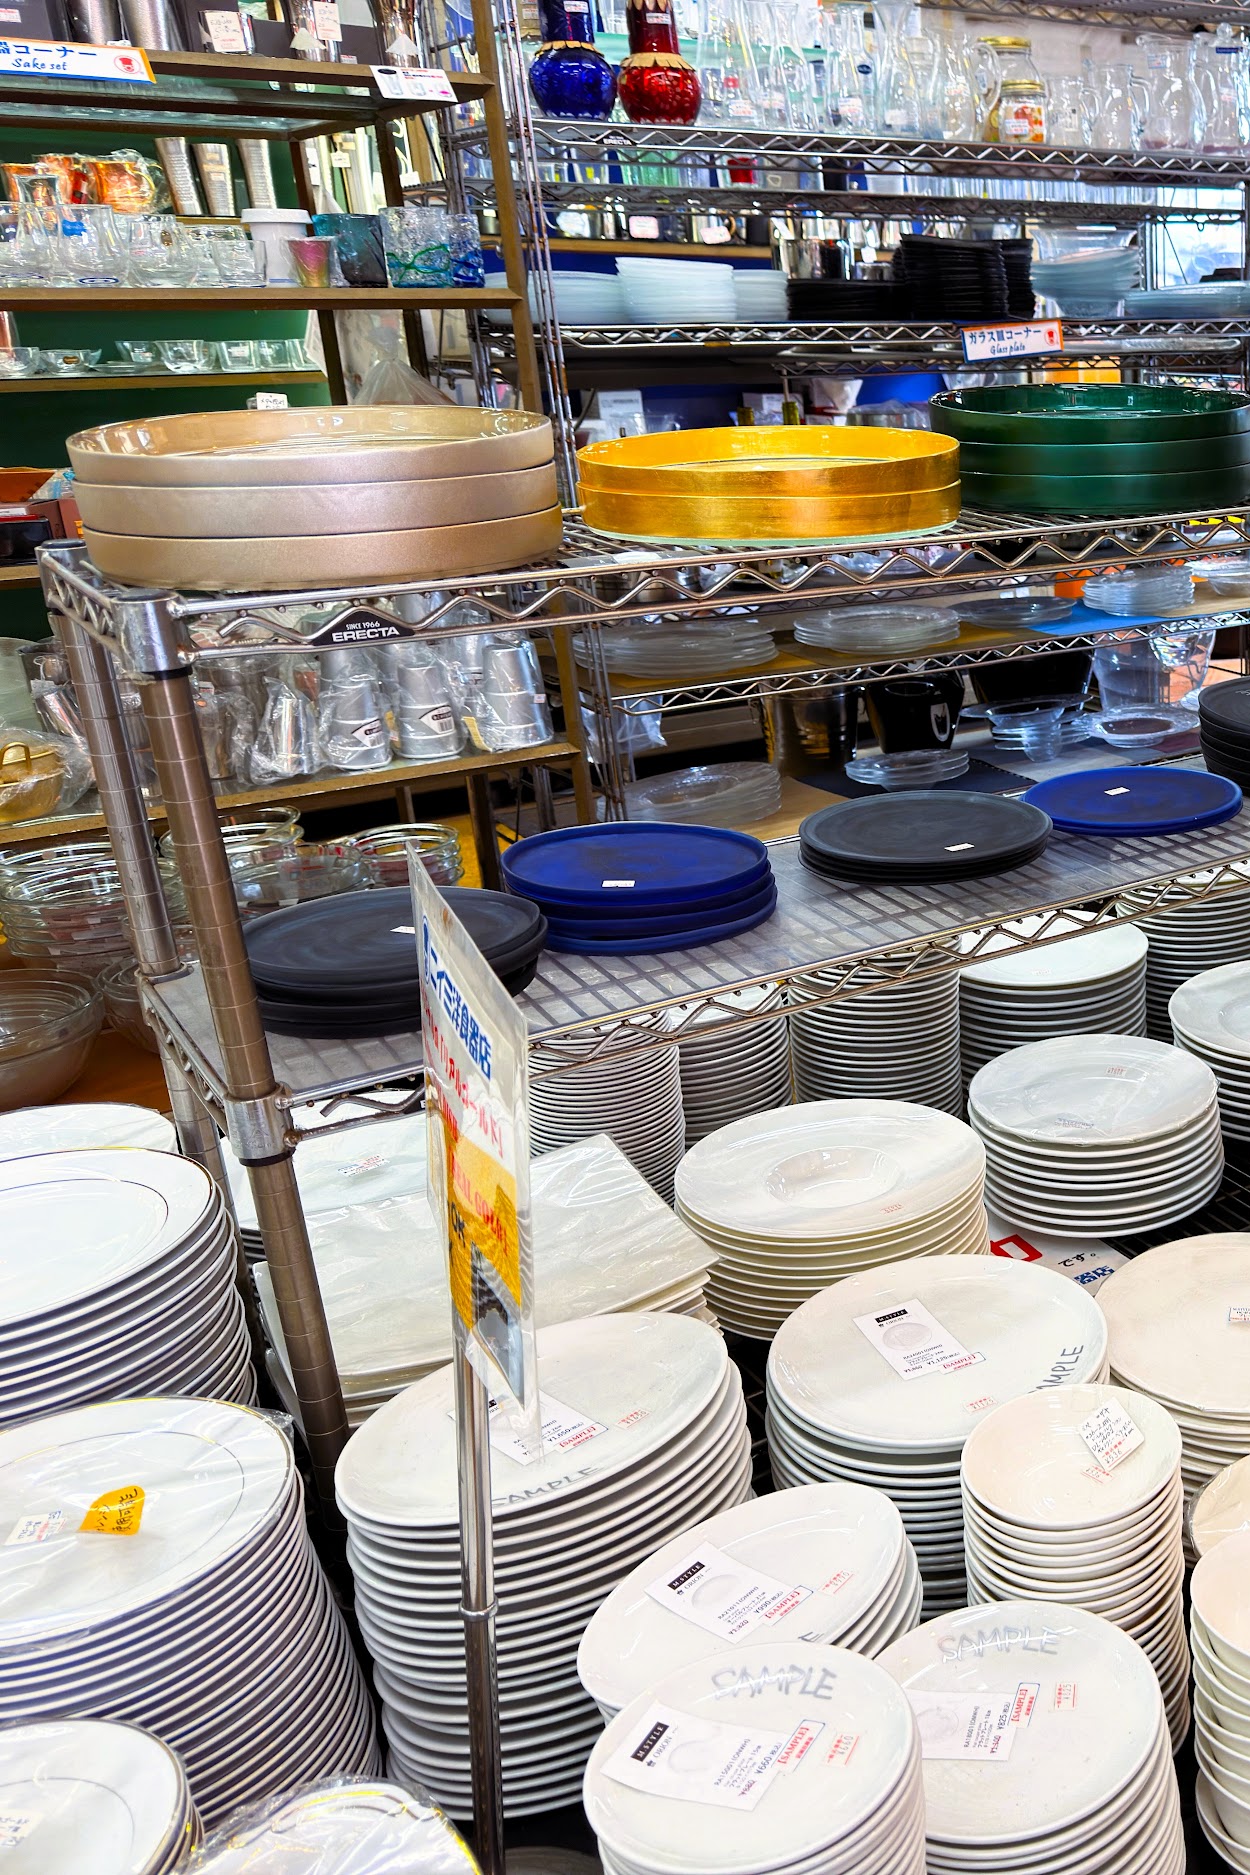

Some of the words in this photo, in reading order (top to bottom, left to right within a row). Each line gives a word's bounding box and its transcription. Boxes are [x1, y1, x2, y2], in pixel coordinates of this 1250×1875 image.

[12, 58, 46, 70] Sake
[51, 62, 67, 71] set
[332, 626, 400, 642] ERECTA
[345, 622, 362, 631] SINCE
[362, 620, 380, 629] 1966
[429, 945, 492, 1081] ニイミ洋食器店
[1028, 1345, 1084, 1393] AMPLE
[491, 1467, 598, 1506] SAMPLE
[672, 1563, 702, 1588] M.STYLE
[938, 1626, 1060, 1662] SAMPLE
[711, 1664, 837, 1700] SAMPLE
[637, 1725, 664, 1759] M.STYLE
[653, 1735, 673, 1759] ORION
[777, 1726, 810, 1764] 【SAMPLE】
